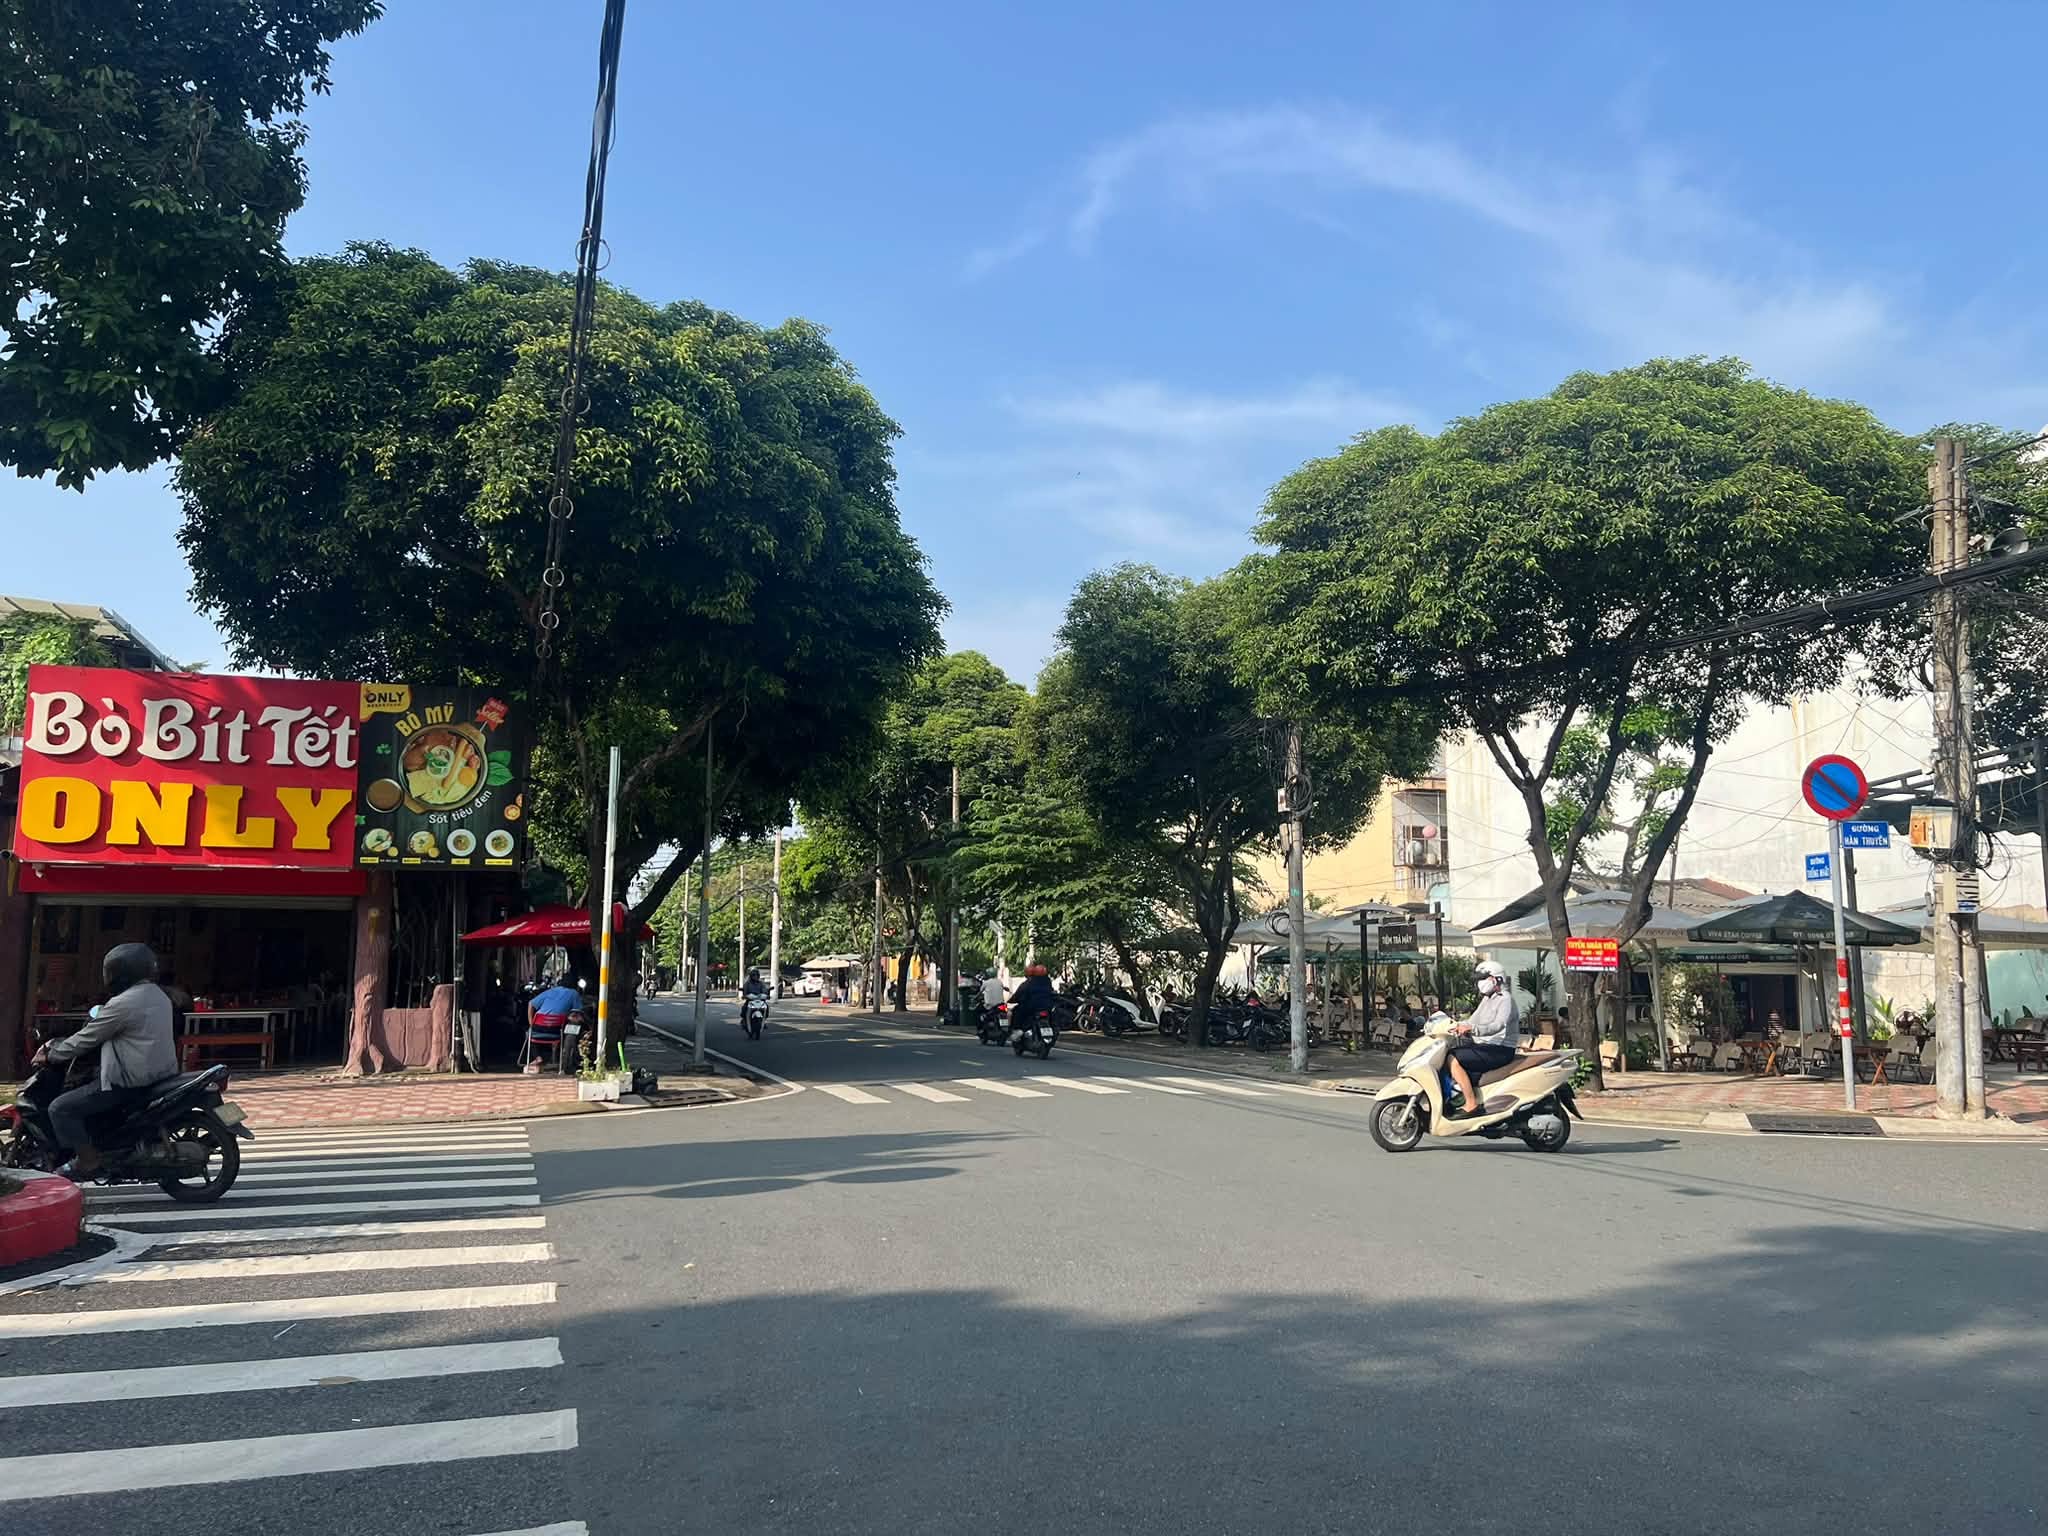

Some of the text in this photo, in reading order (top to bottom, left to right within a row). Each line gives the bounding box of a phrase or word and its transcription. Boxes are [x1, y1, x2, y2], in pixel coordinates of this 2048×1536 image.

[366, 691, 404, 703] ONLY
[26, 691, 356, 768] Bò Bít Tết
[395, 711, 421, 737] BÒ
[20, 776, 352, 850] ONLY
[428, 789, 492, 824] Sốt tiêu đen
[1844, 836, 1859, 846] HÀN
[1851, 823, 1879, 833] ĐƯỜNG
